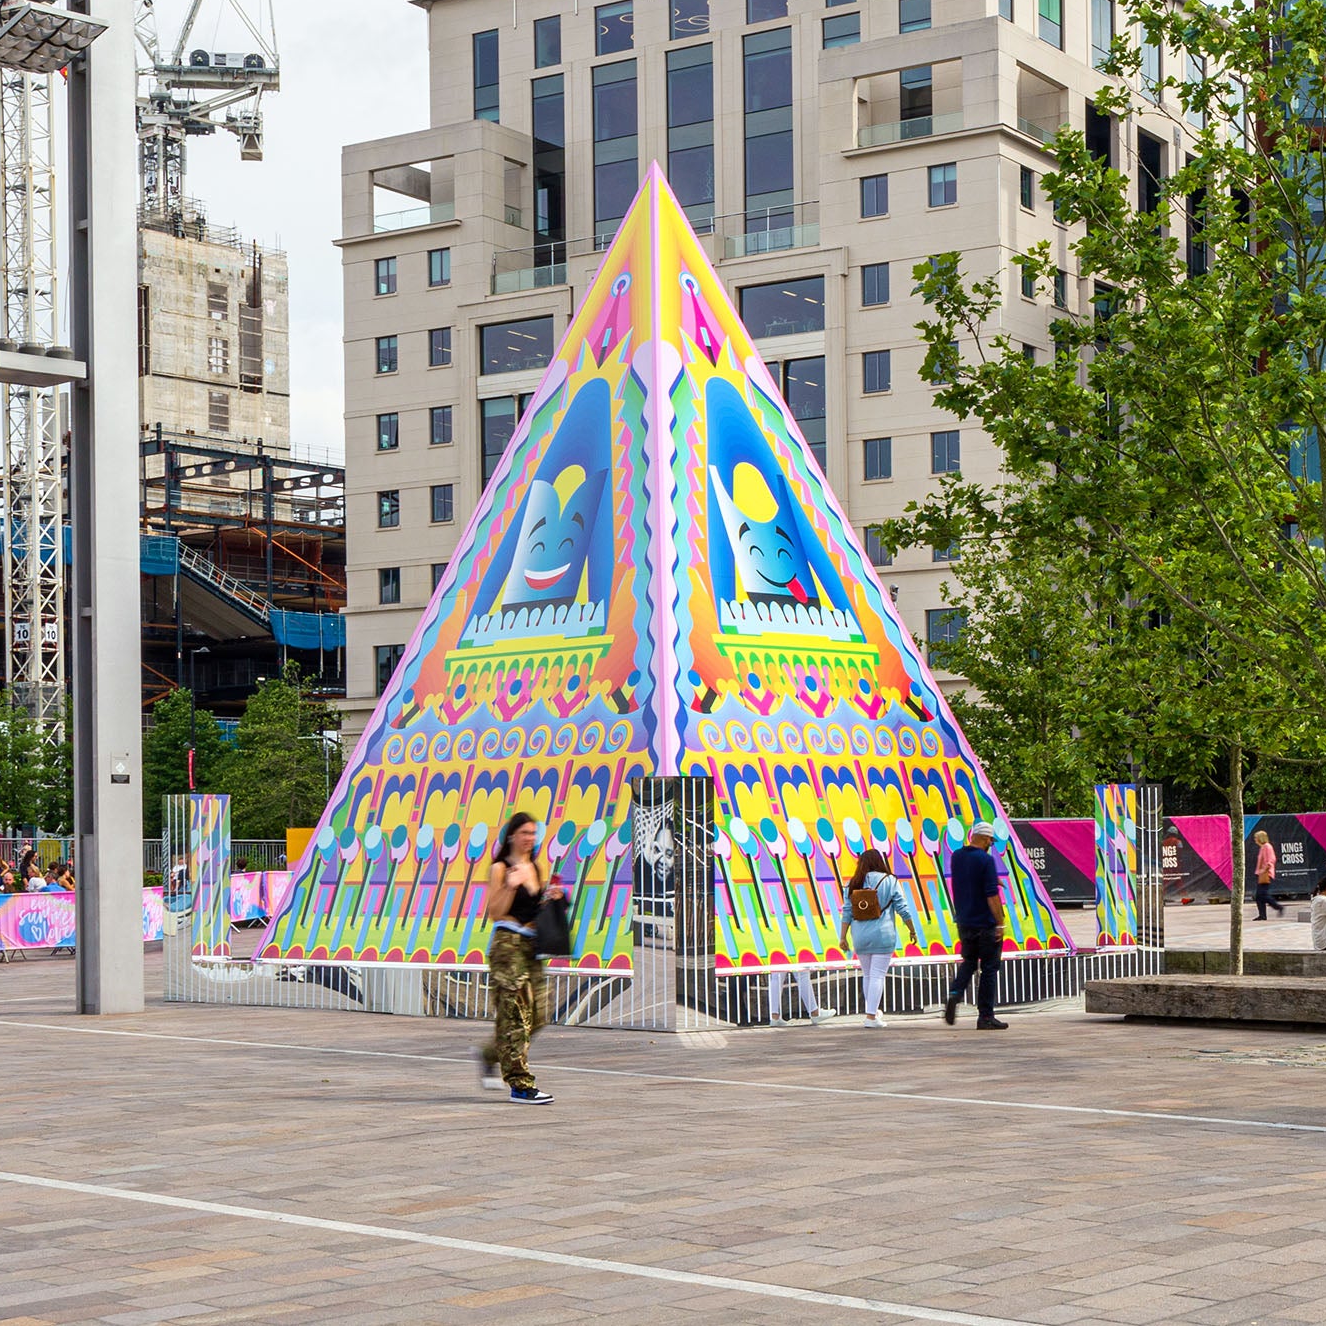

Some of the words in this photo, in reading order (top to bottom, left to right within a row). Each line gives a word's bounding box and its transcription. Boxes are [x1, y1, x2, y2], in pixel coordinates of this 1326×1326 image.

[17, 630, 29, 639] 10
[47, 631, 56, 640] 10
[1162, 846, 1177, 857] NGS
[1162, 857, 1178, 868] OSS
[1281, 853, 1305, 864] CROSS
